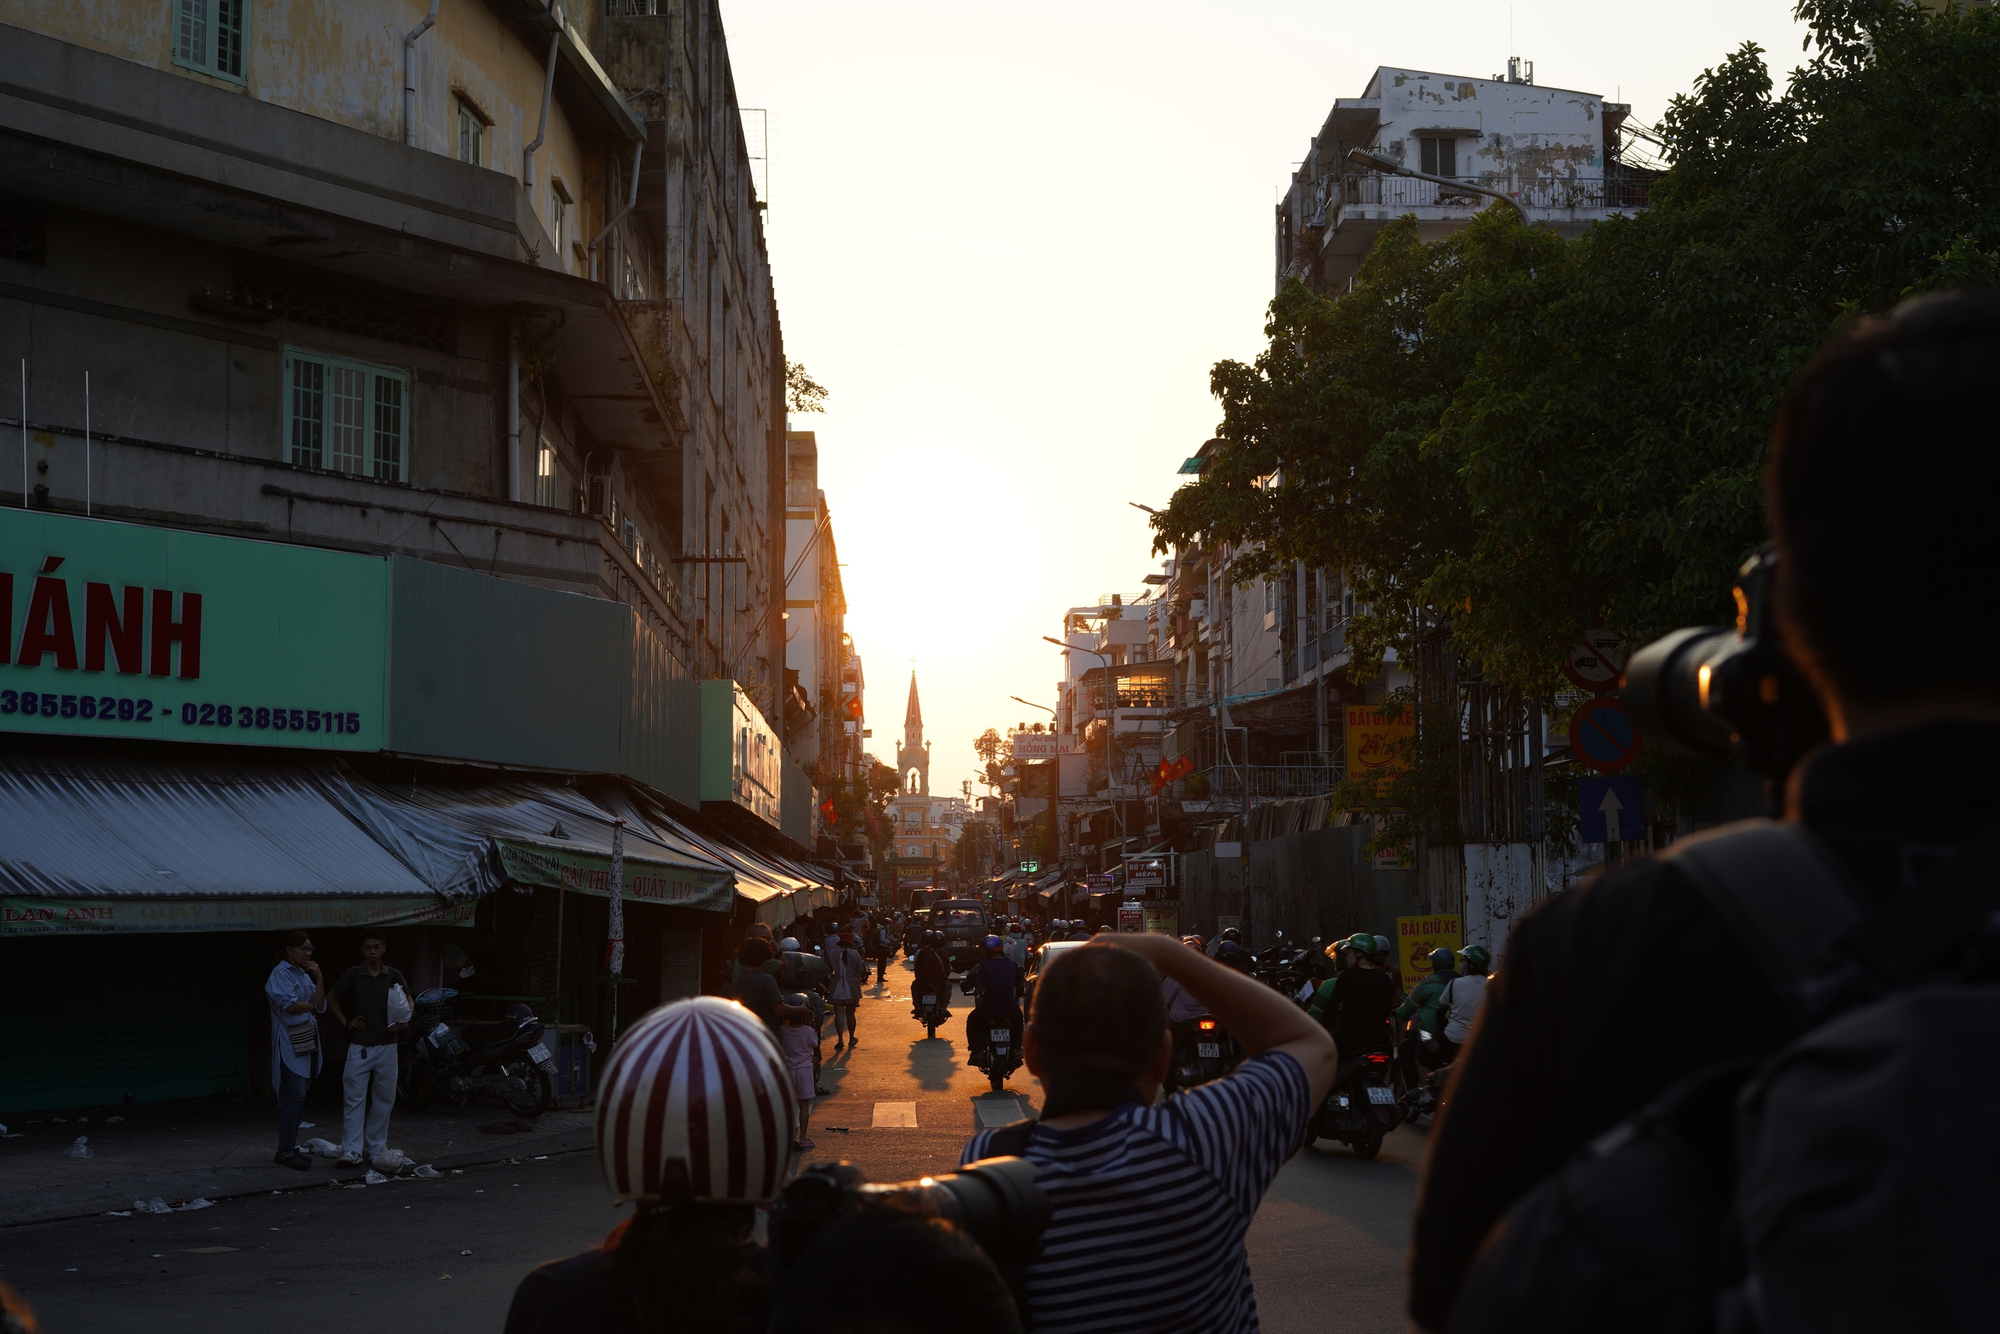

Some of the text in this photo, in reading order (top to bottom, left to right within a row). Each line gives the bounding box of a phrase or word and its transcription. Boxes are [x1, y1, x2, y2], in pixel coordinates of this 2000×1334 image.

[181, 702, 232, 726] 028
[238, 706, 361, 734] 38555115
[1349, 708, 1370, 726] BÃI
[1049, 745, 1070, 753] MAI
[587, 864, 612, 892] THỦ
[633, 867, 667, 898] QUẦY
[671, 881, 693, 901] 112
[4, 907, 56, 922] LAN
[62, 907, 116, 921] ANH
[215, 905, 254, 917] 113
[452, 906, 473, 921] 112
[1401, 919, 1458, 936] BÃI GIỮ XE
